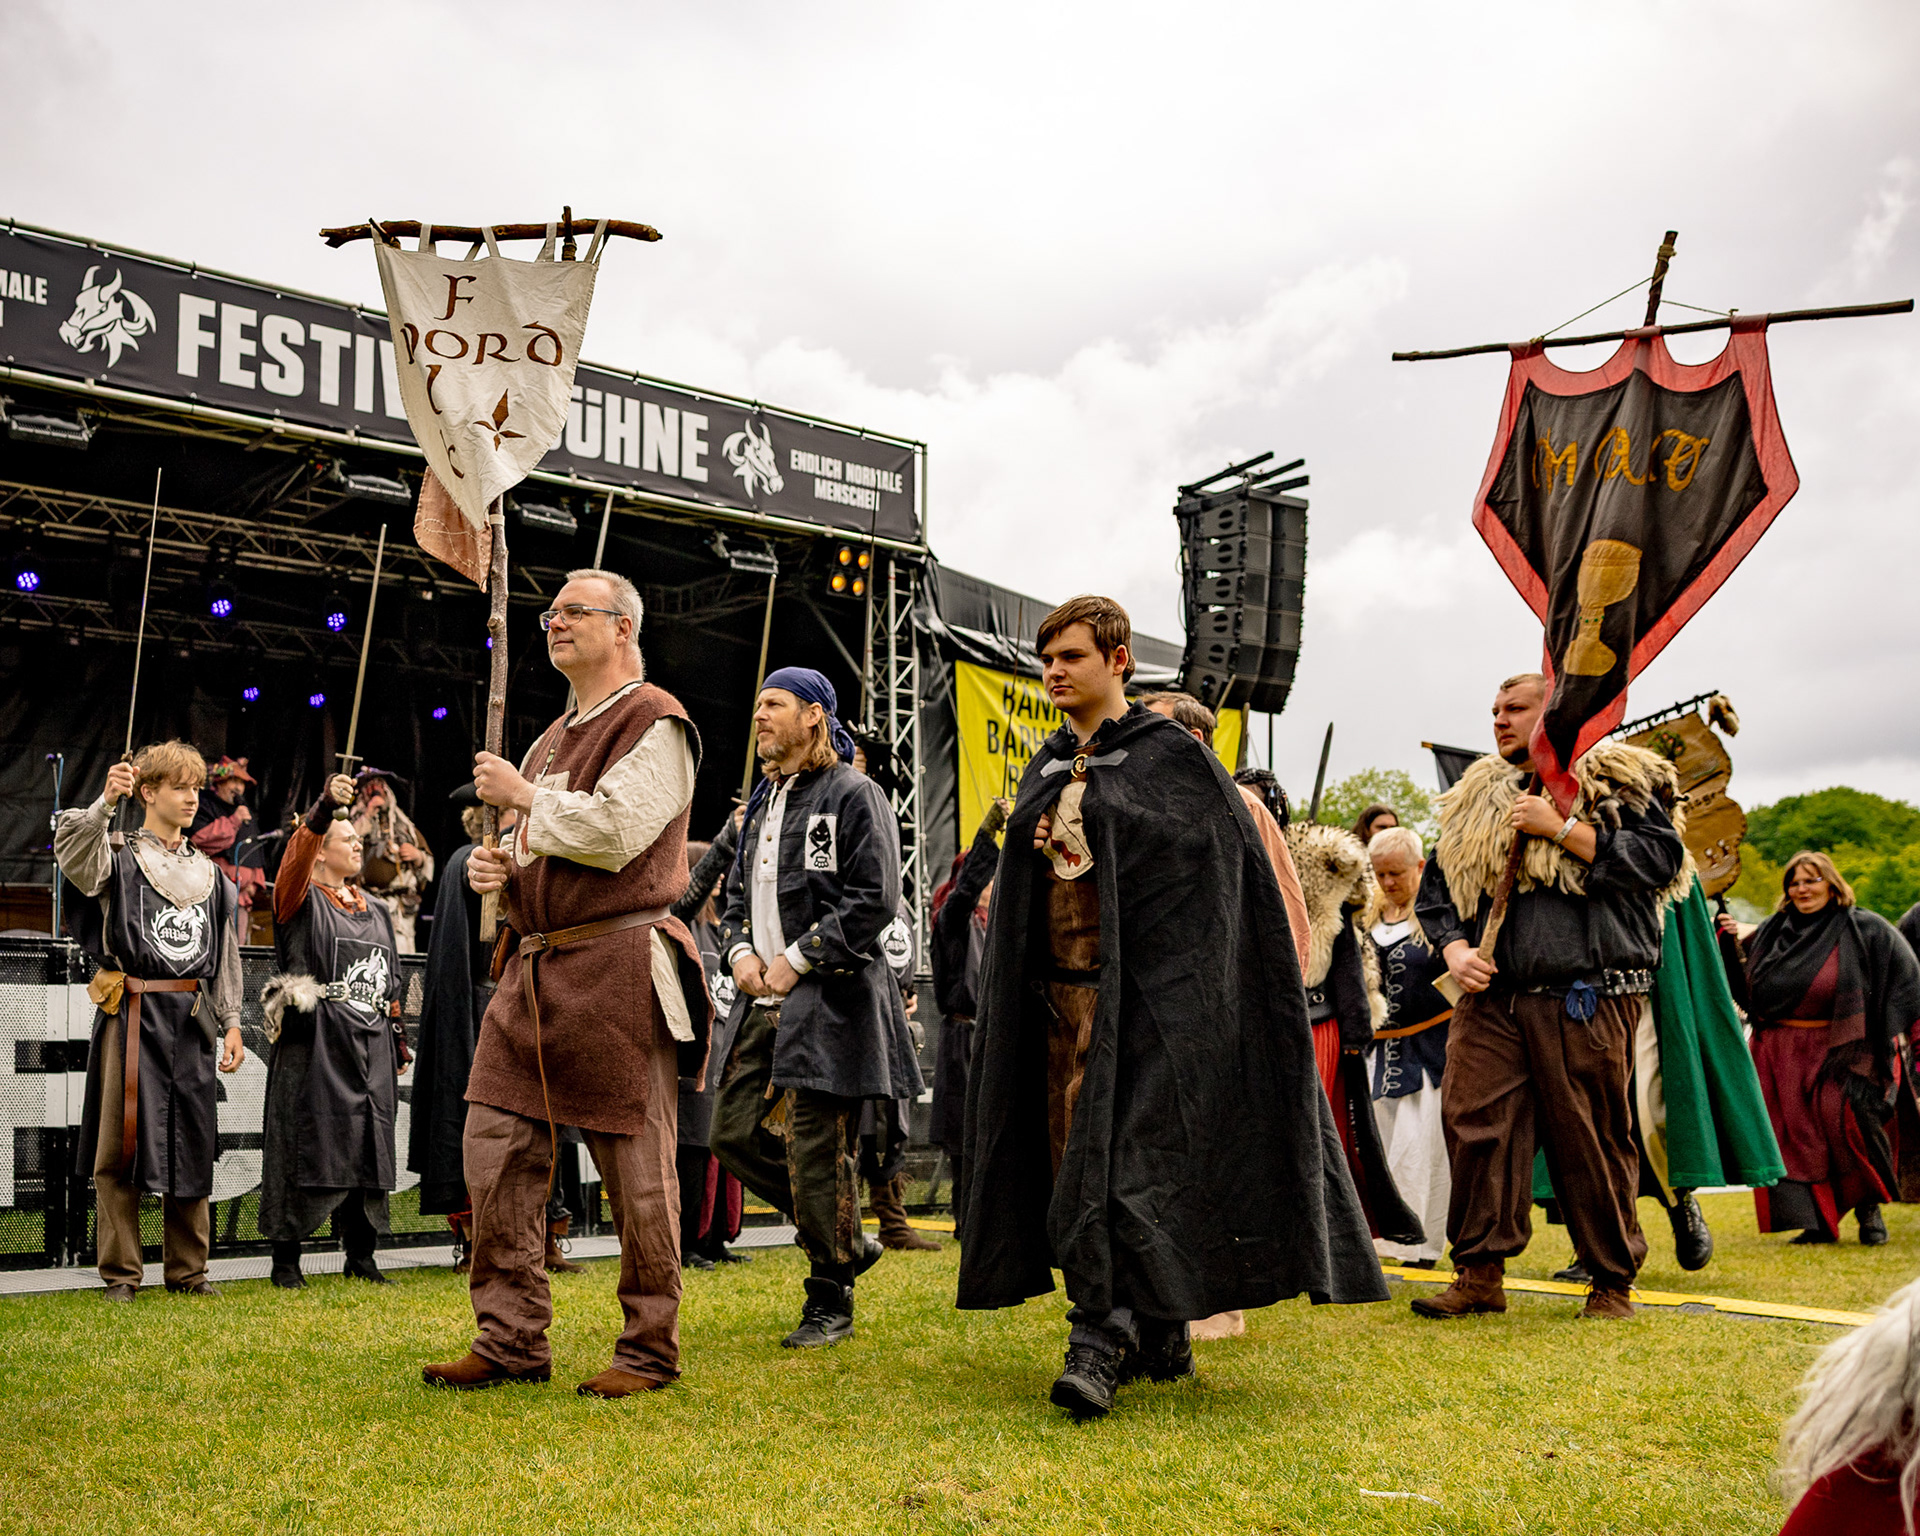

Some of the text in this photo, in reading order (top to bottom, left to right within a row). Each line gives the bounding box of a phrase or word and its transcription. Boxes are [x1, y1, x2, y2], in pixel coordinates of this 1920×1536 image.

[550, 384, 709, 483] ÜHNE
[790, 448, 903, 494] ENDLICH NORMALE
[814, 477, 880, 511] MENSCHEN
[987, 719, 1057, 759] BARH
